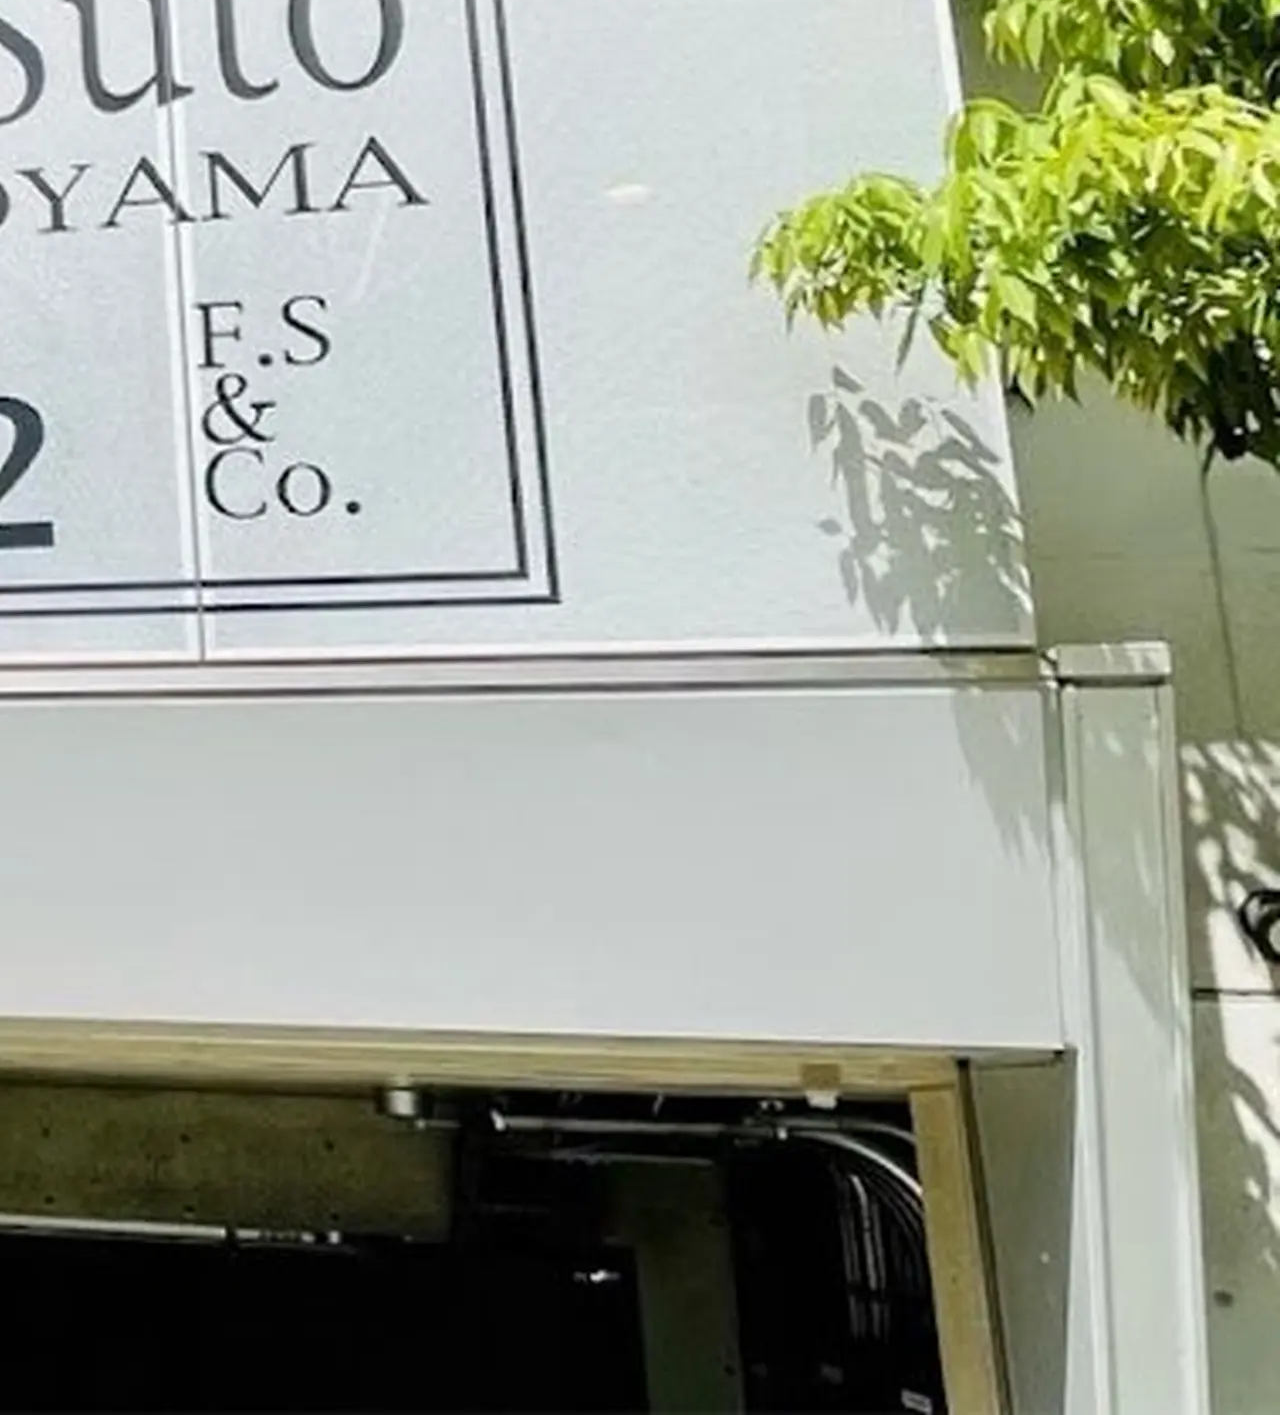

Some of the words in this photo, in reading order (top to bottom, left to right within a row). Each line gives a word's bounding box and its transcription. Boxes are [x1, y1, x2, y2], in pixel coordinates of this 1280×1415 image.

[195, 294, 331, 369] F.S
[201, 373, 276, 446] &
[204, 447, 362, 519] Co.
